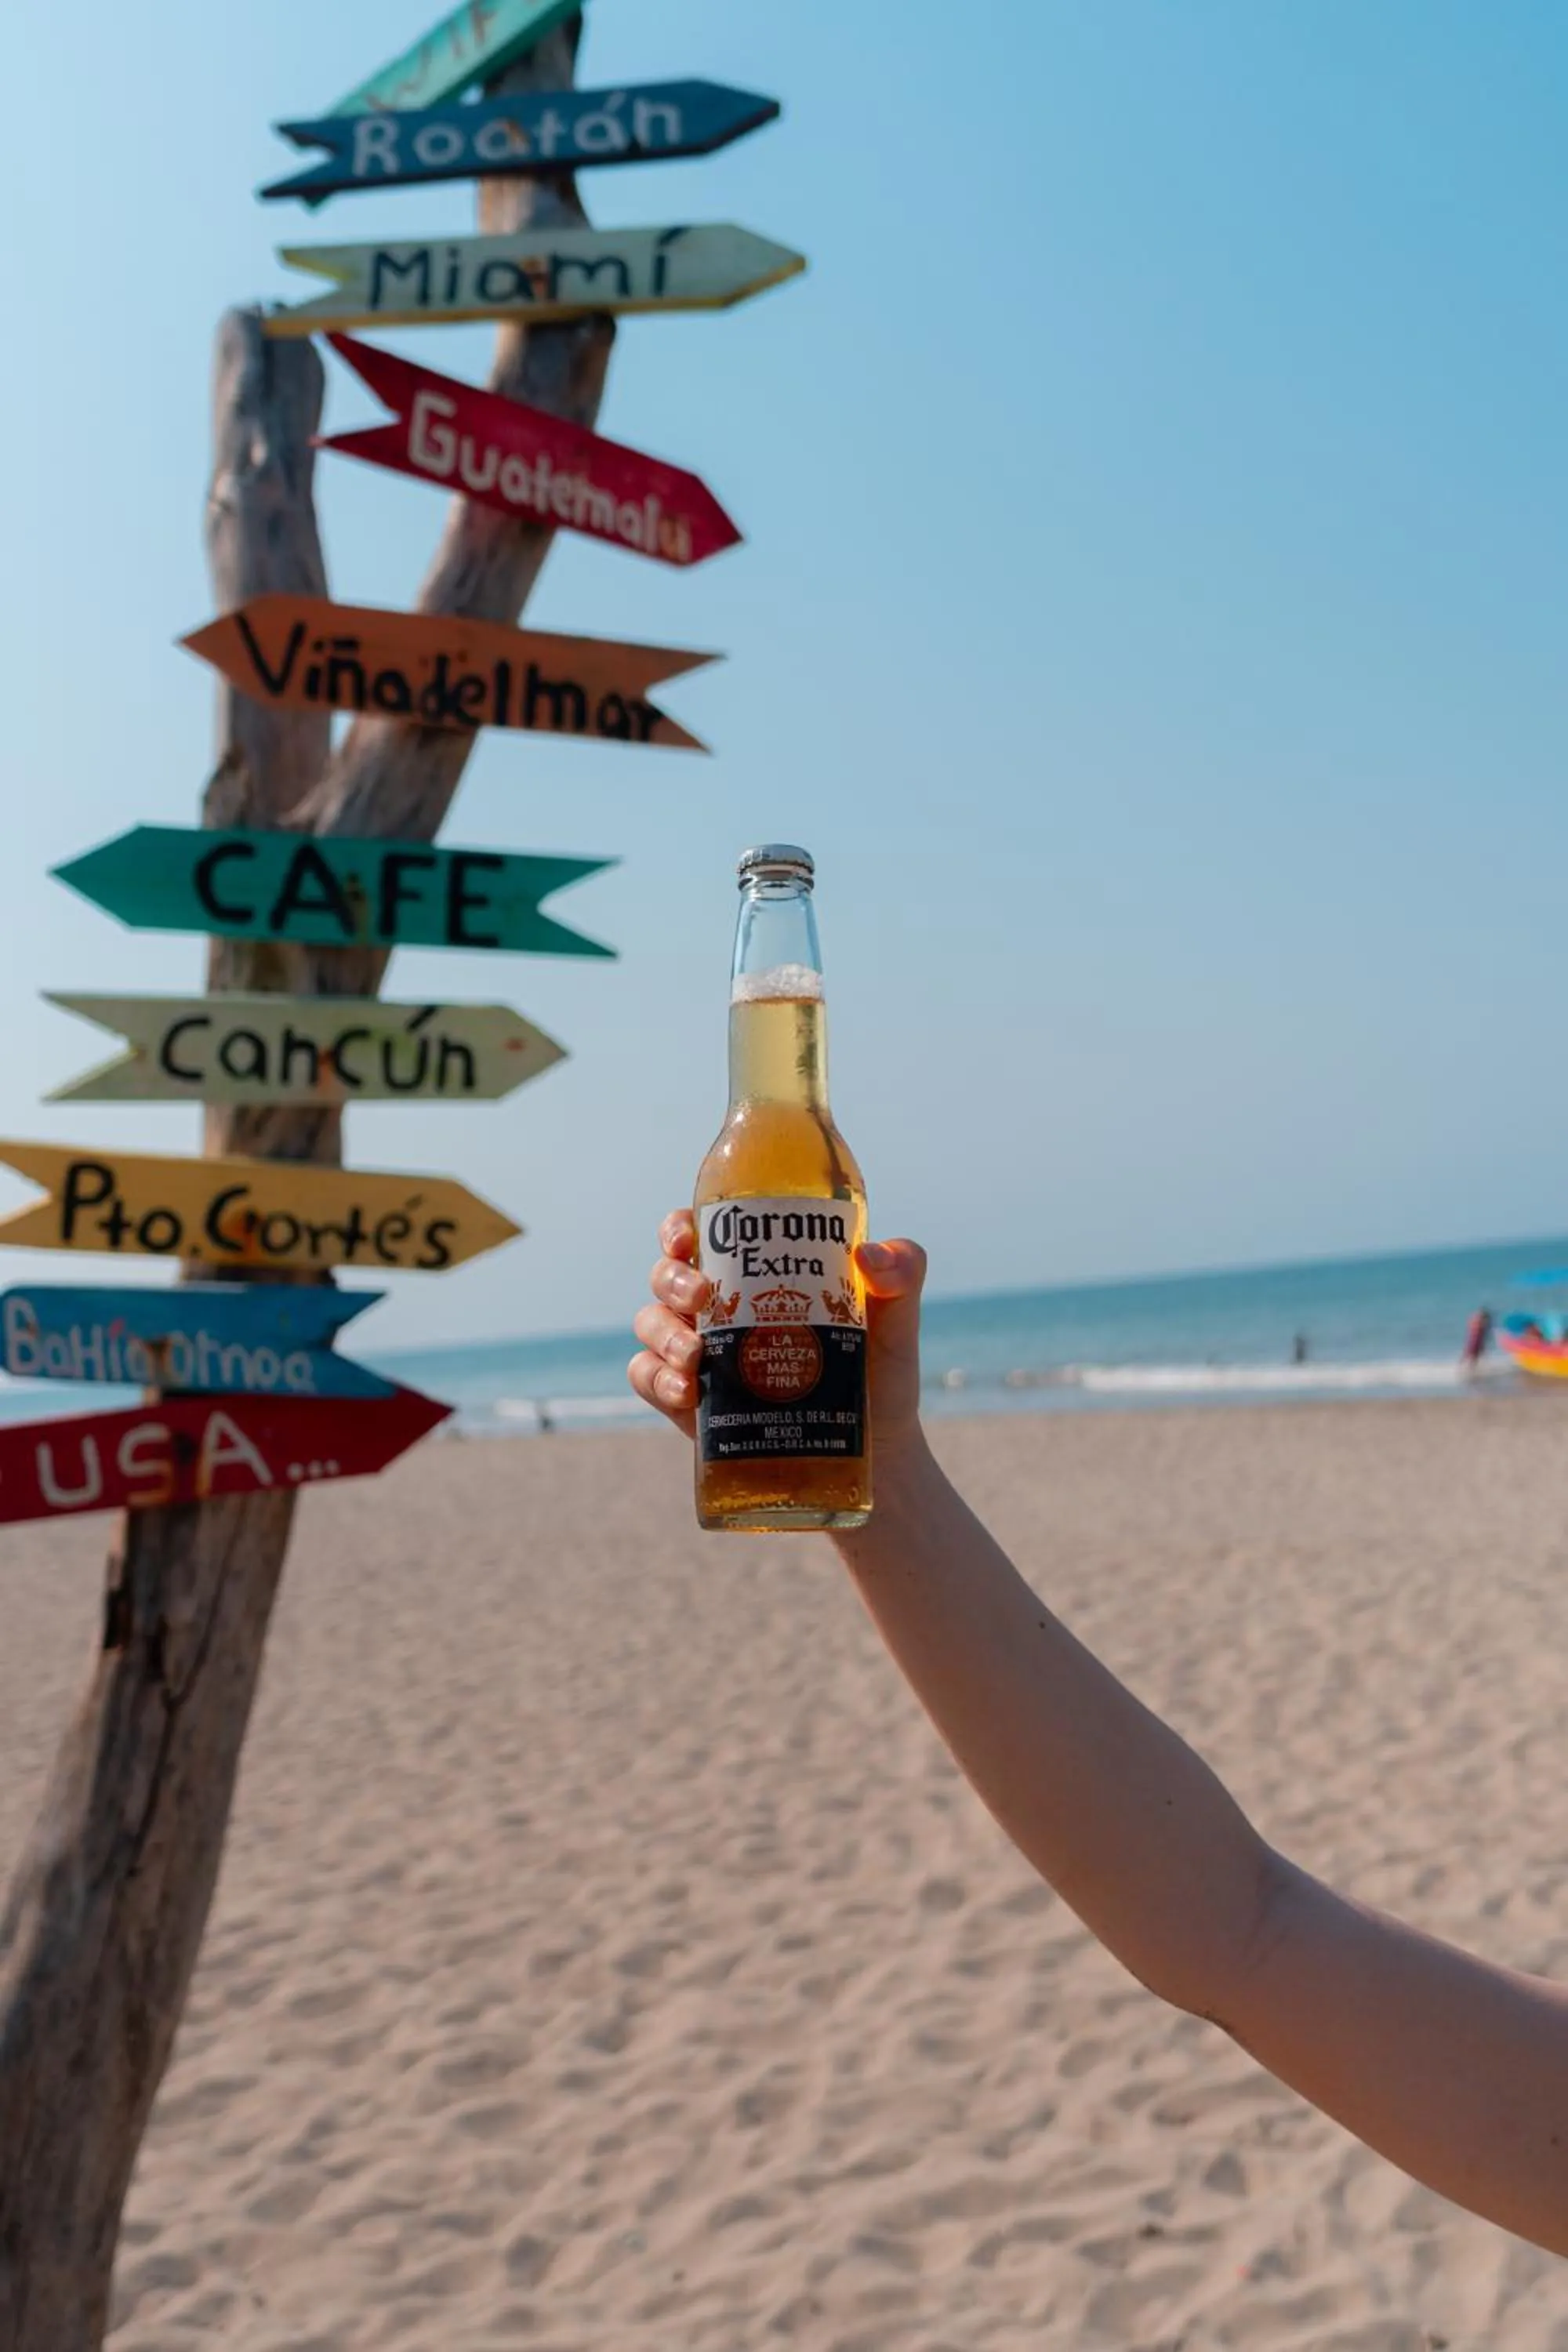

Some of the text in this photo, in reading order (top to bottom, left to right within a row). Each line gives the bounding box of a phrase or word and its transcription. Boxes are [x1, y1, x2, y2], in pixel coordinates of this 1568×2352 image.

[351, 93, 684, 177] Roatán
[368, 226, 691, 310] Miamí
[408, 390, 691, 561] Guatemala
[193, 841, 506, 947] CAFE
[161, 1004, 477, 1091] Cancún
[60, 1162, 458, 1270] Pto. Cortés
[708, 1205, 847, 1258] Corona
[742, 1247, 825, 1277] Extra
[749, 1347, 817, 1362] CERVEZA
[766, 1376, 801, 1389] FINA
[772, 1334, 793, 1347] LA
